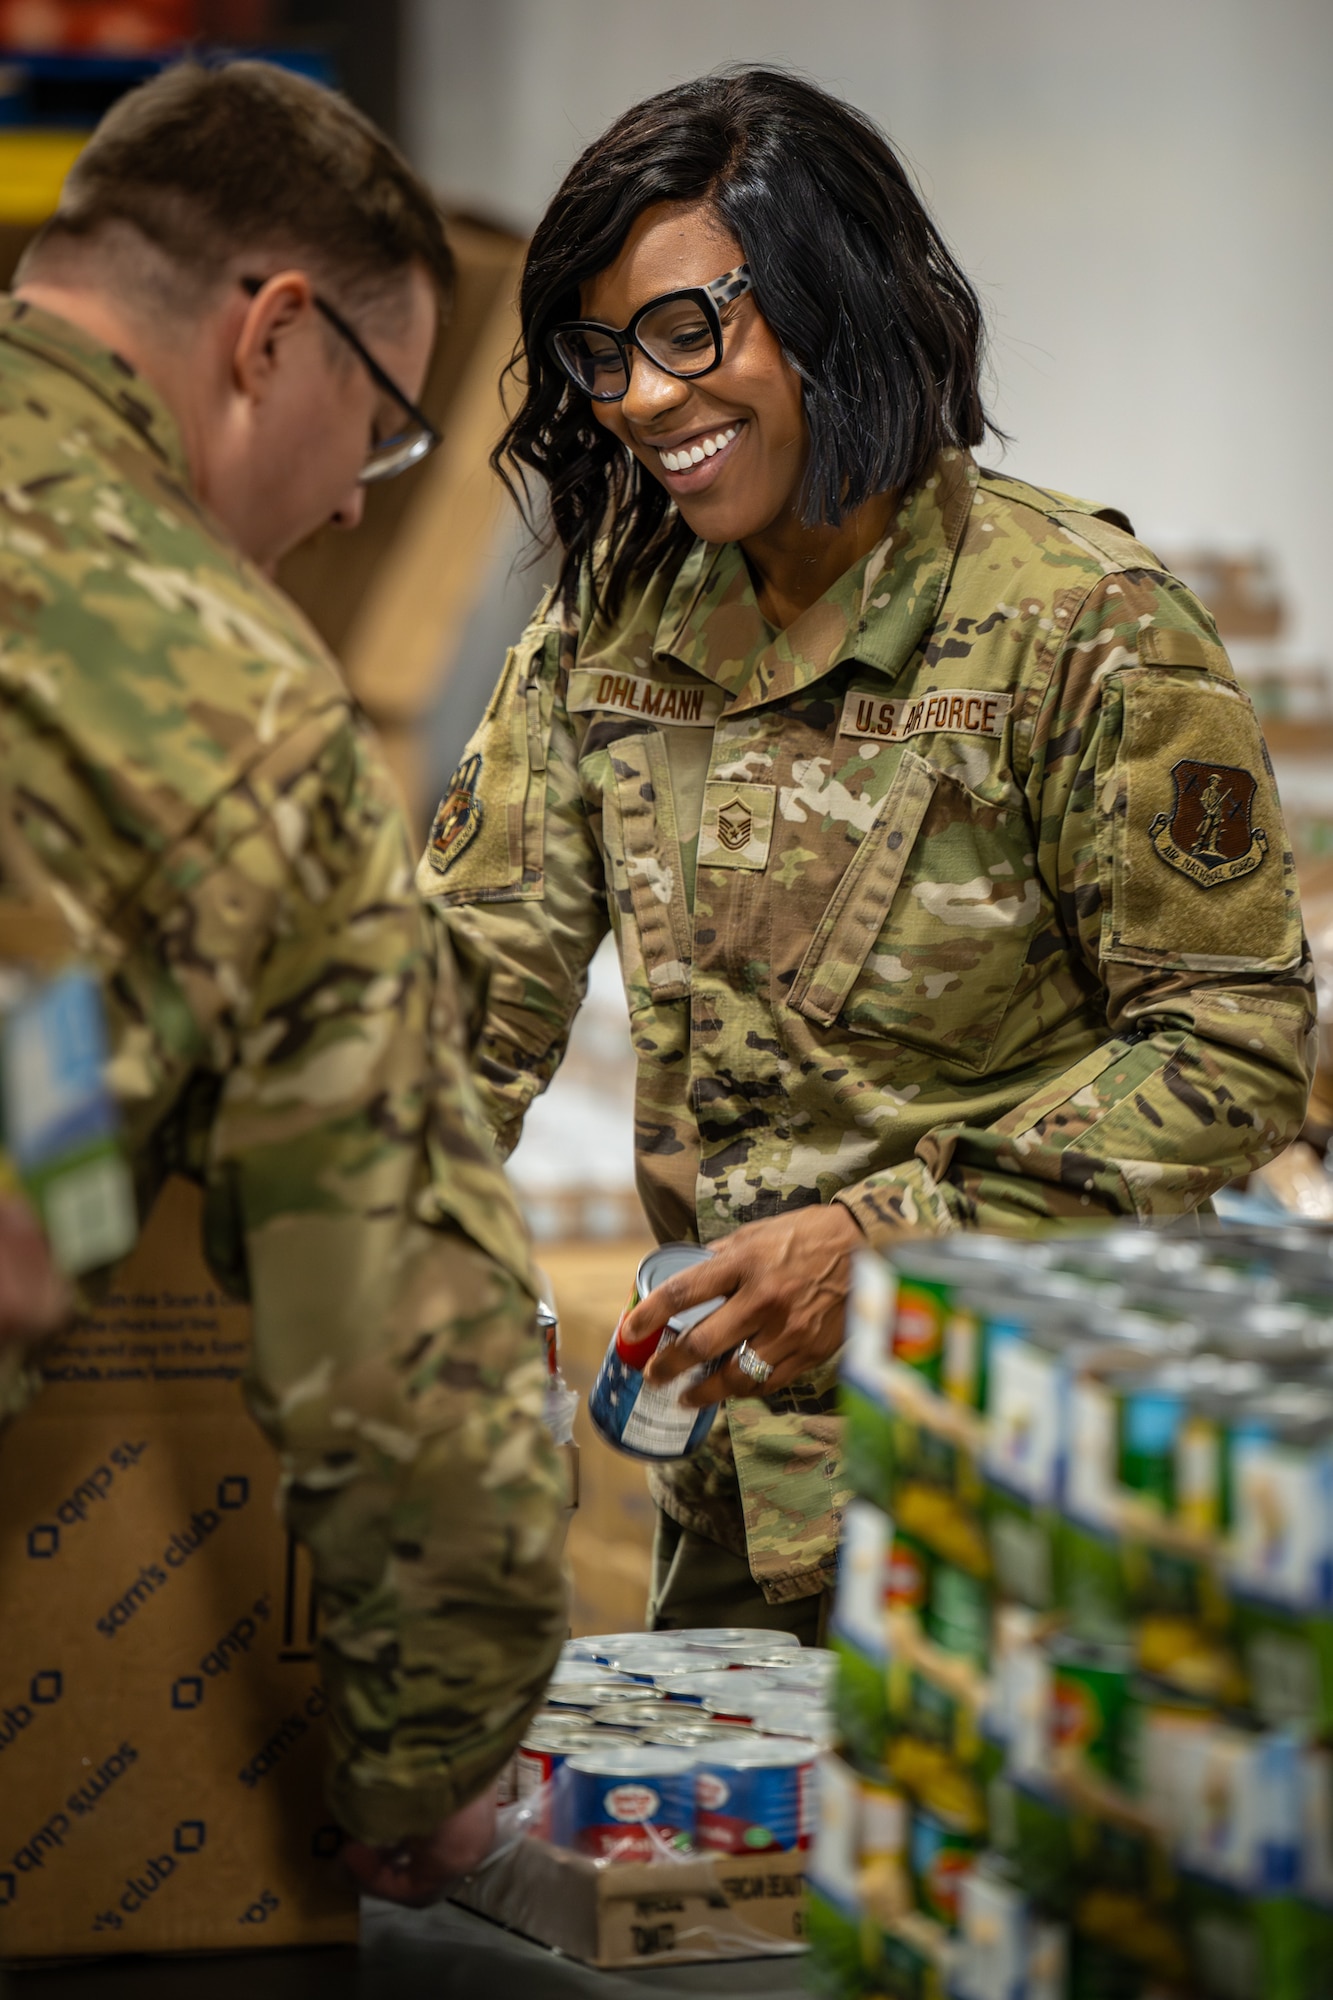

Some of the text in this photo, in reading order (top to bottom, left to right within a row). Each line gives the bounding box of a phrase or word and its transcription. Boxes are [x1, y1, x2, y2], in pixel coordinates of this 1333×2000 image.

[596, 674, 705, 722] OHLMANN
[856, 699, 897, 737] U.S.
[924, 695, 998, 732] FORCE
[1162, 846, 1180, 861] AIR
[1181, 858, 1225, 883] NATIONAL
[56, 1465, 114, 1525] club
[95, 1508, 222, 1639] sam's club
[199, 1617, 257, 1678] club
[11, 1740, 140, 1874] sam's club
[119, 1853, 178, 1914] club
